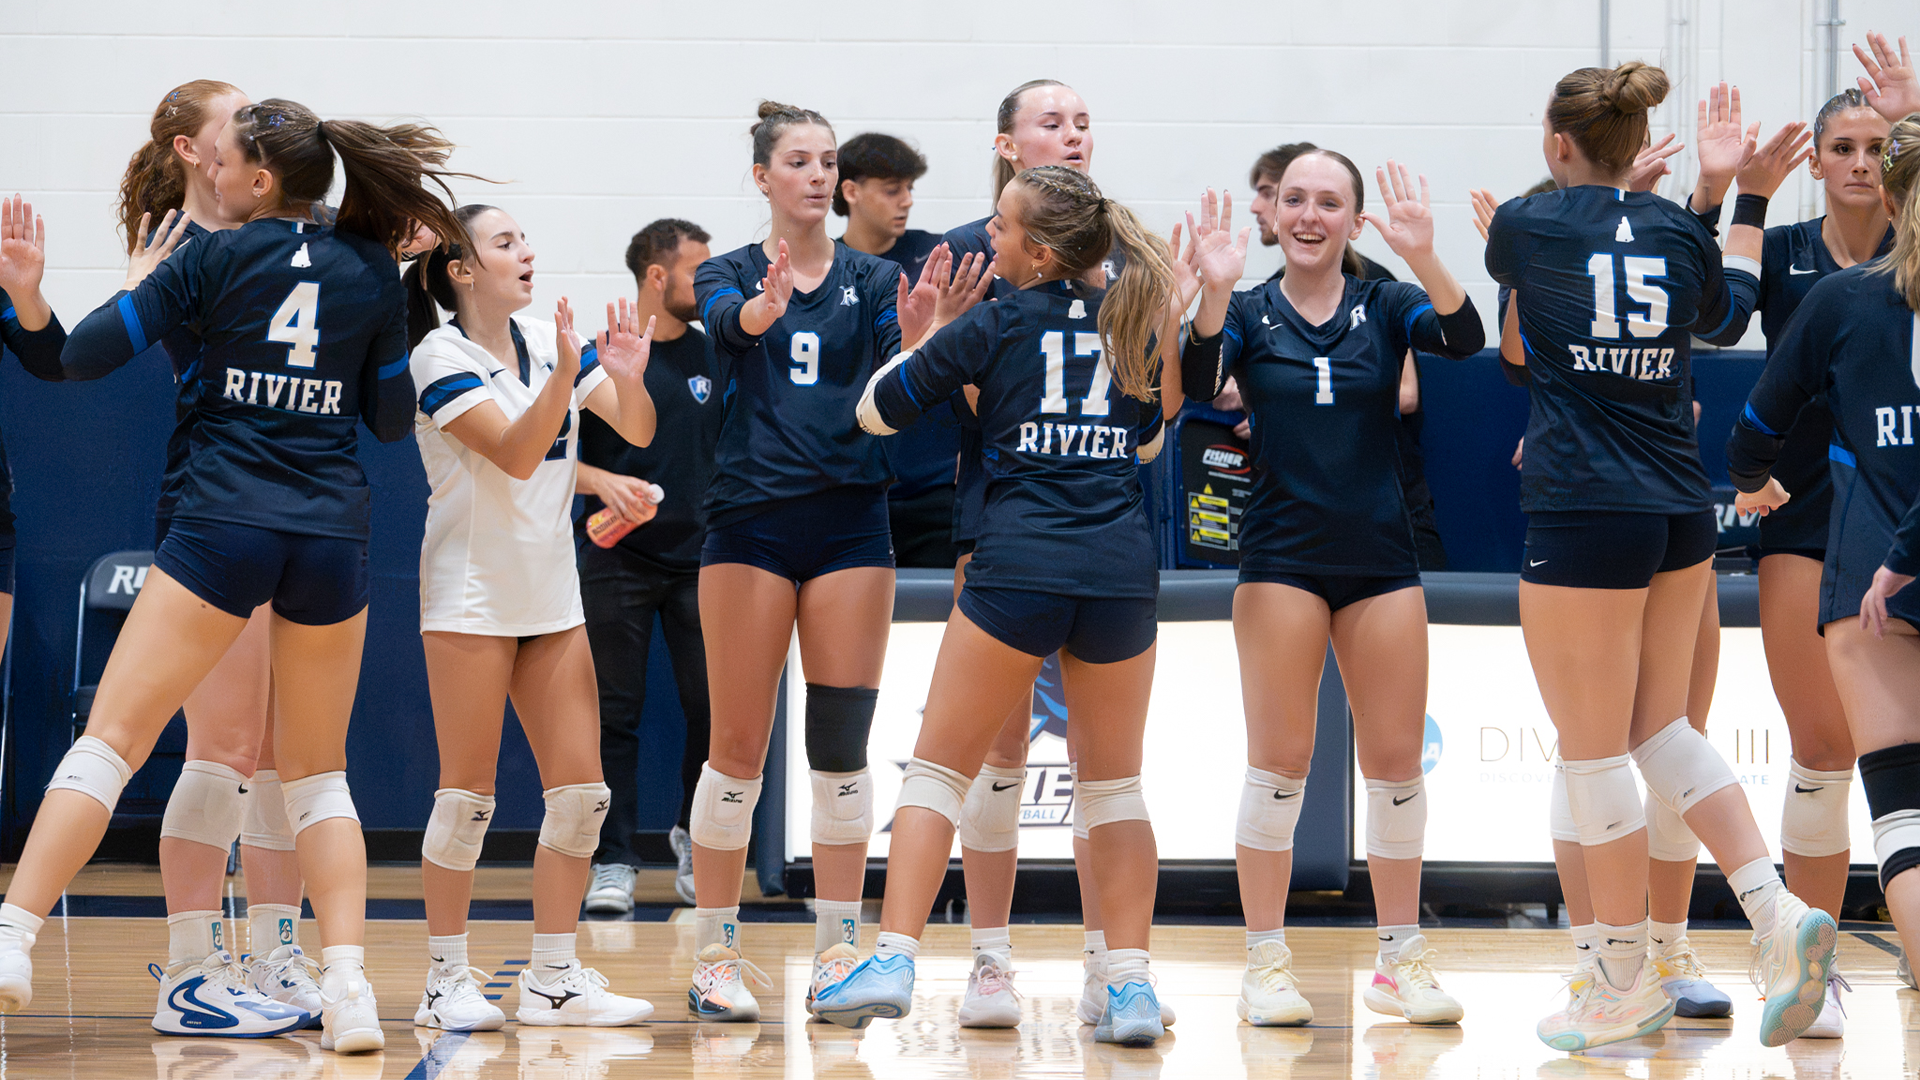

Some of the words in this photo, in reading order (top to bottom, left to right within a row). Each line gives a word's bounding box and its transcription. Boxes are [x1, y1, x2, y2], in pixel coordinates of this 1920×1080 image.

[839, 285, 860, 306] R
[1587, 252, 1670, 340] 15
[266, 280, 320, 369] 4
[1349, 304, 1367, 331] R
[788, 330, 821, 387] 9
[1040, 330, 1116, 416] 17
[1568, 344, 1675, 380] RIVIER
[223, 367, 343, 415] RIVIER
[1312, 356, 1335, 406] 1
[1016, 421, 1128, 459] RIVIER
[1875, 405, 1920, 447] RI
[107, 564, 151, 595] RI
[1479, 771, 1554, 784] DISCOVE
[1020, 809, 1056, 820] BALL
